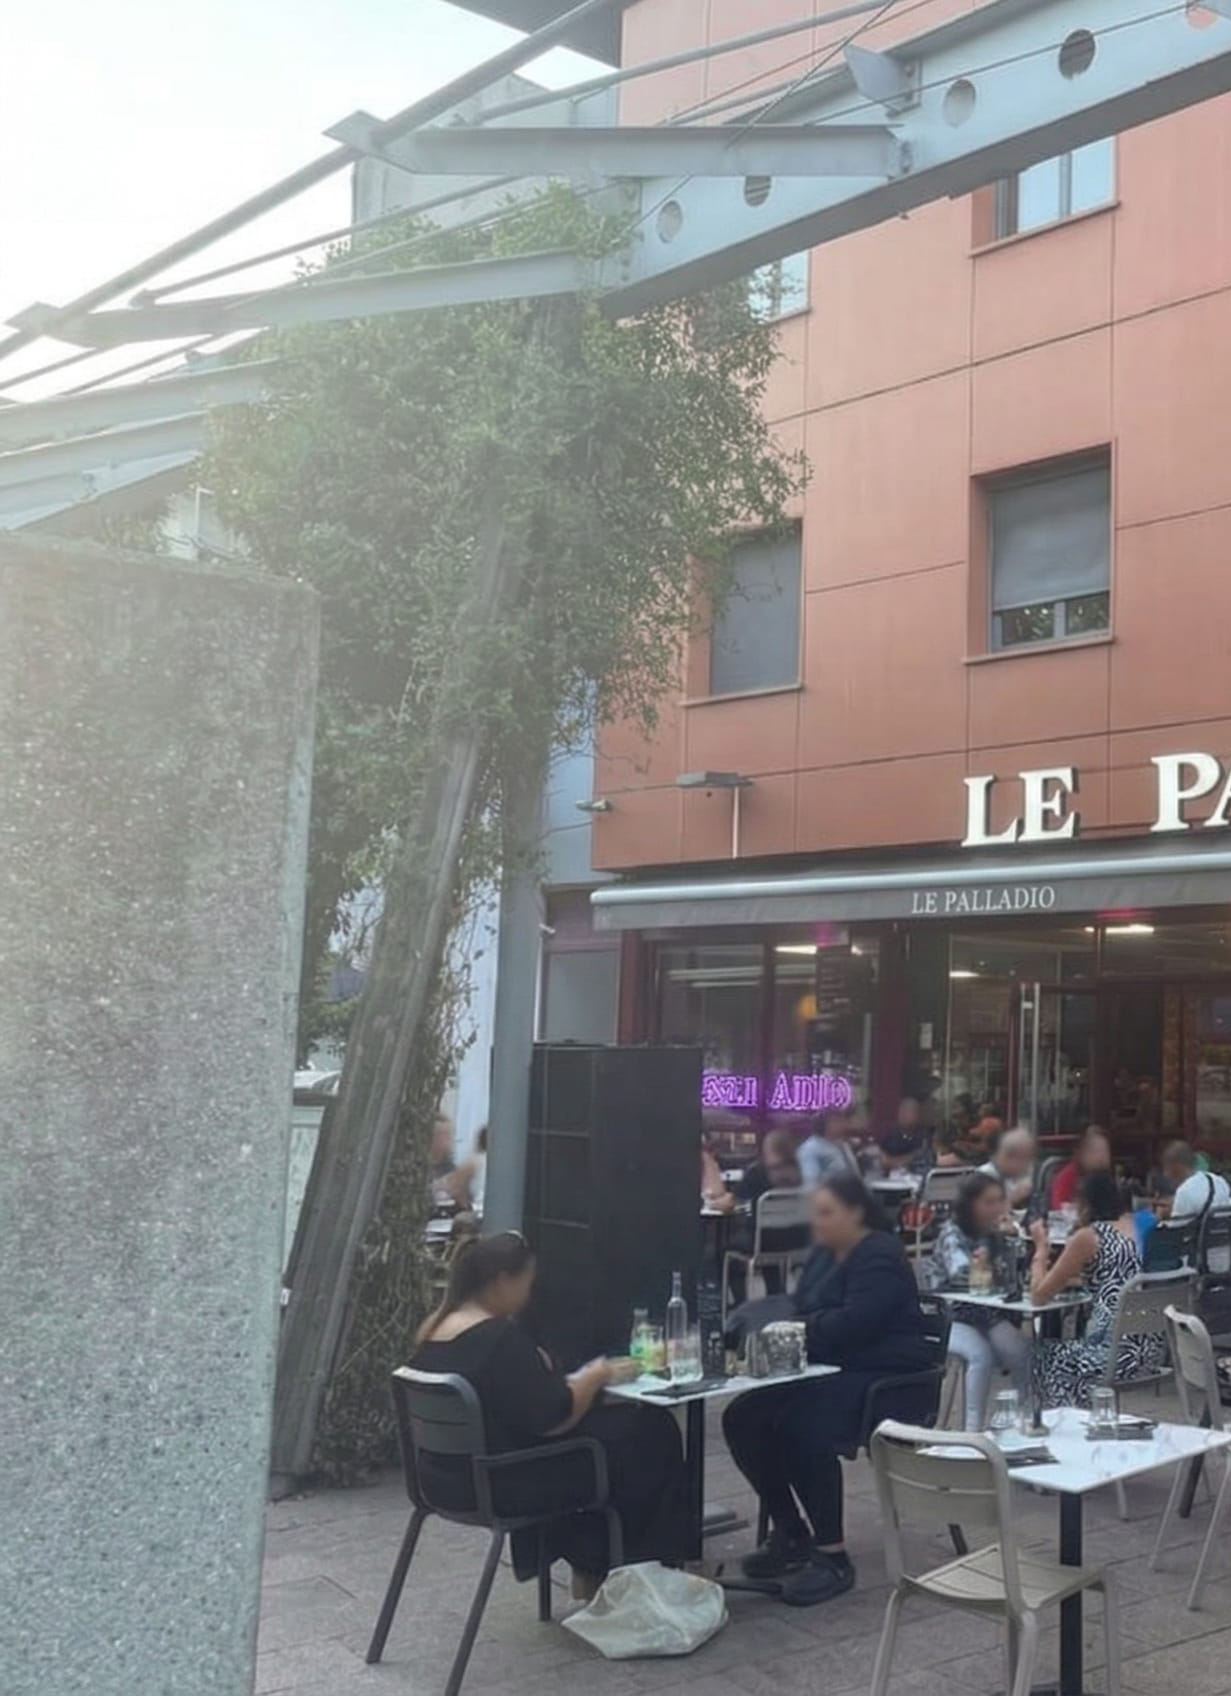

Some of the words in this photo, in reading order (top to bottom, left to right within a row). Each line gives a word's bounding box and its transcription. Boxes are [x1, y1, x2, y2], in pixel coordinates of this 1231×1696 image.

[961, 766, 1077, 848] LE
[912, 891, 938, 914] LE
[944, 886, 1056, 913] PALLADIO
